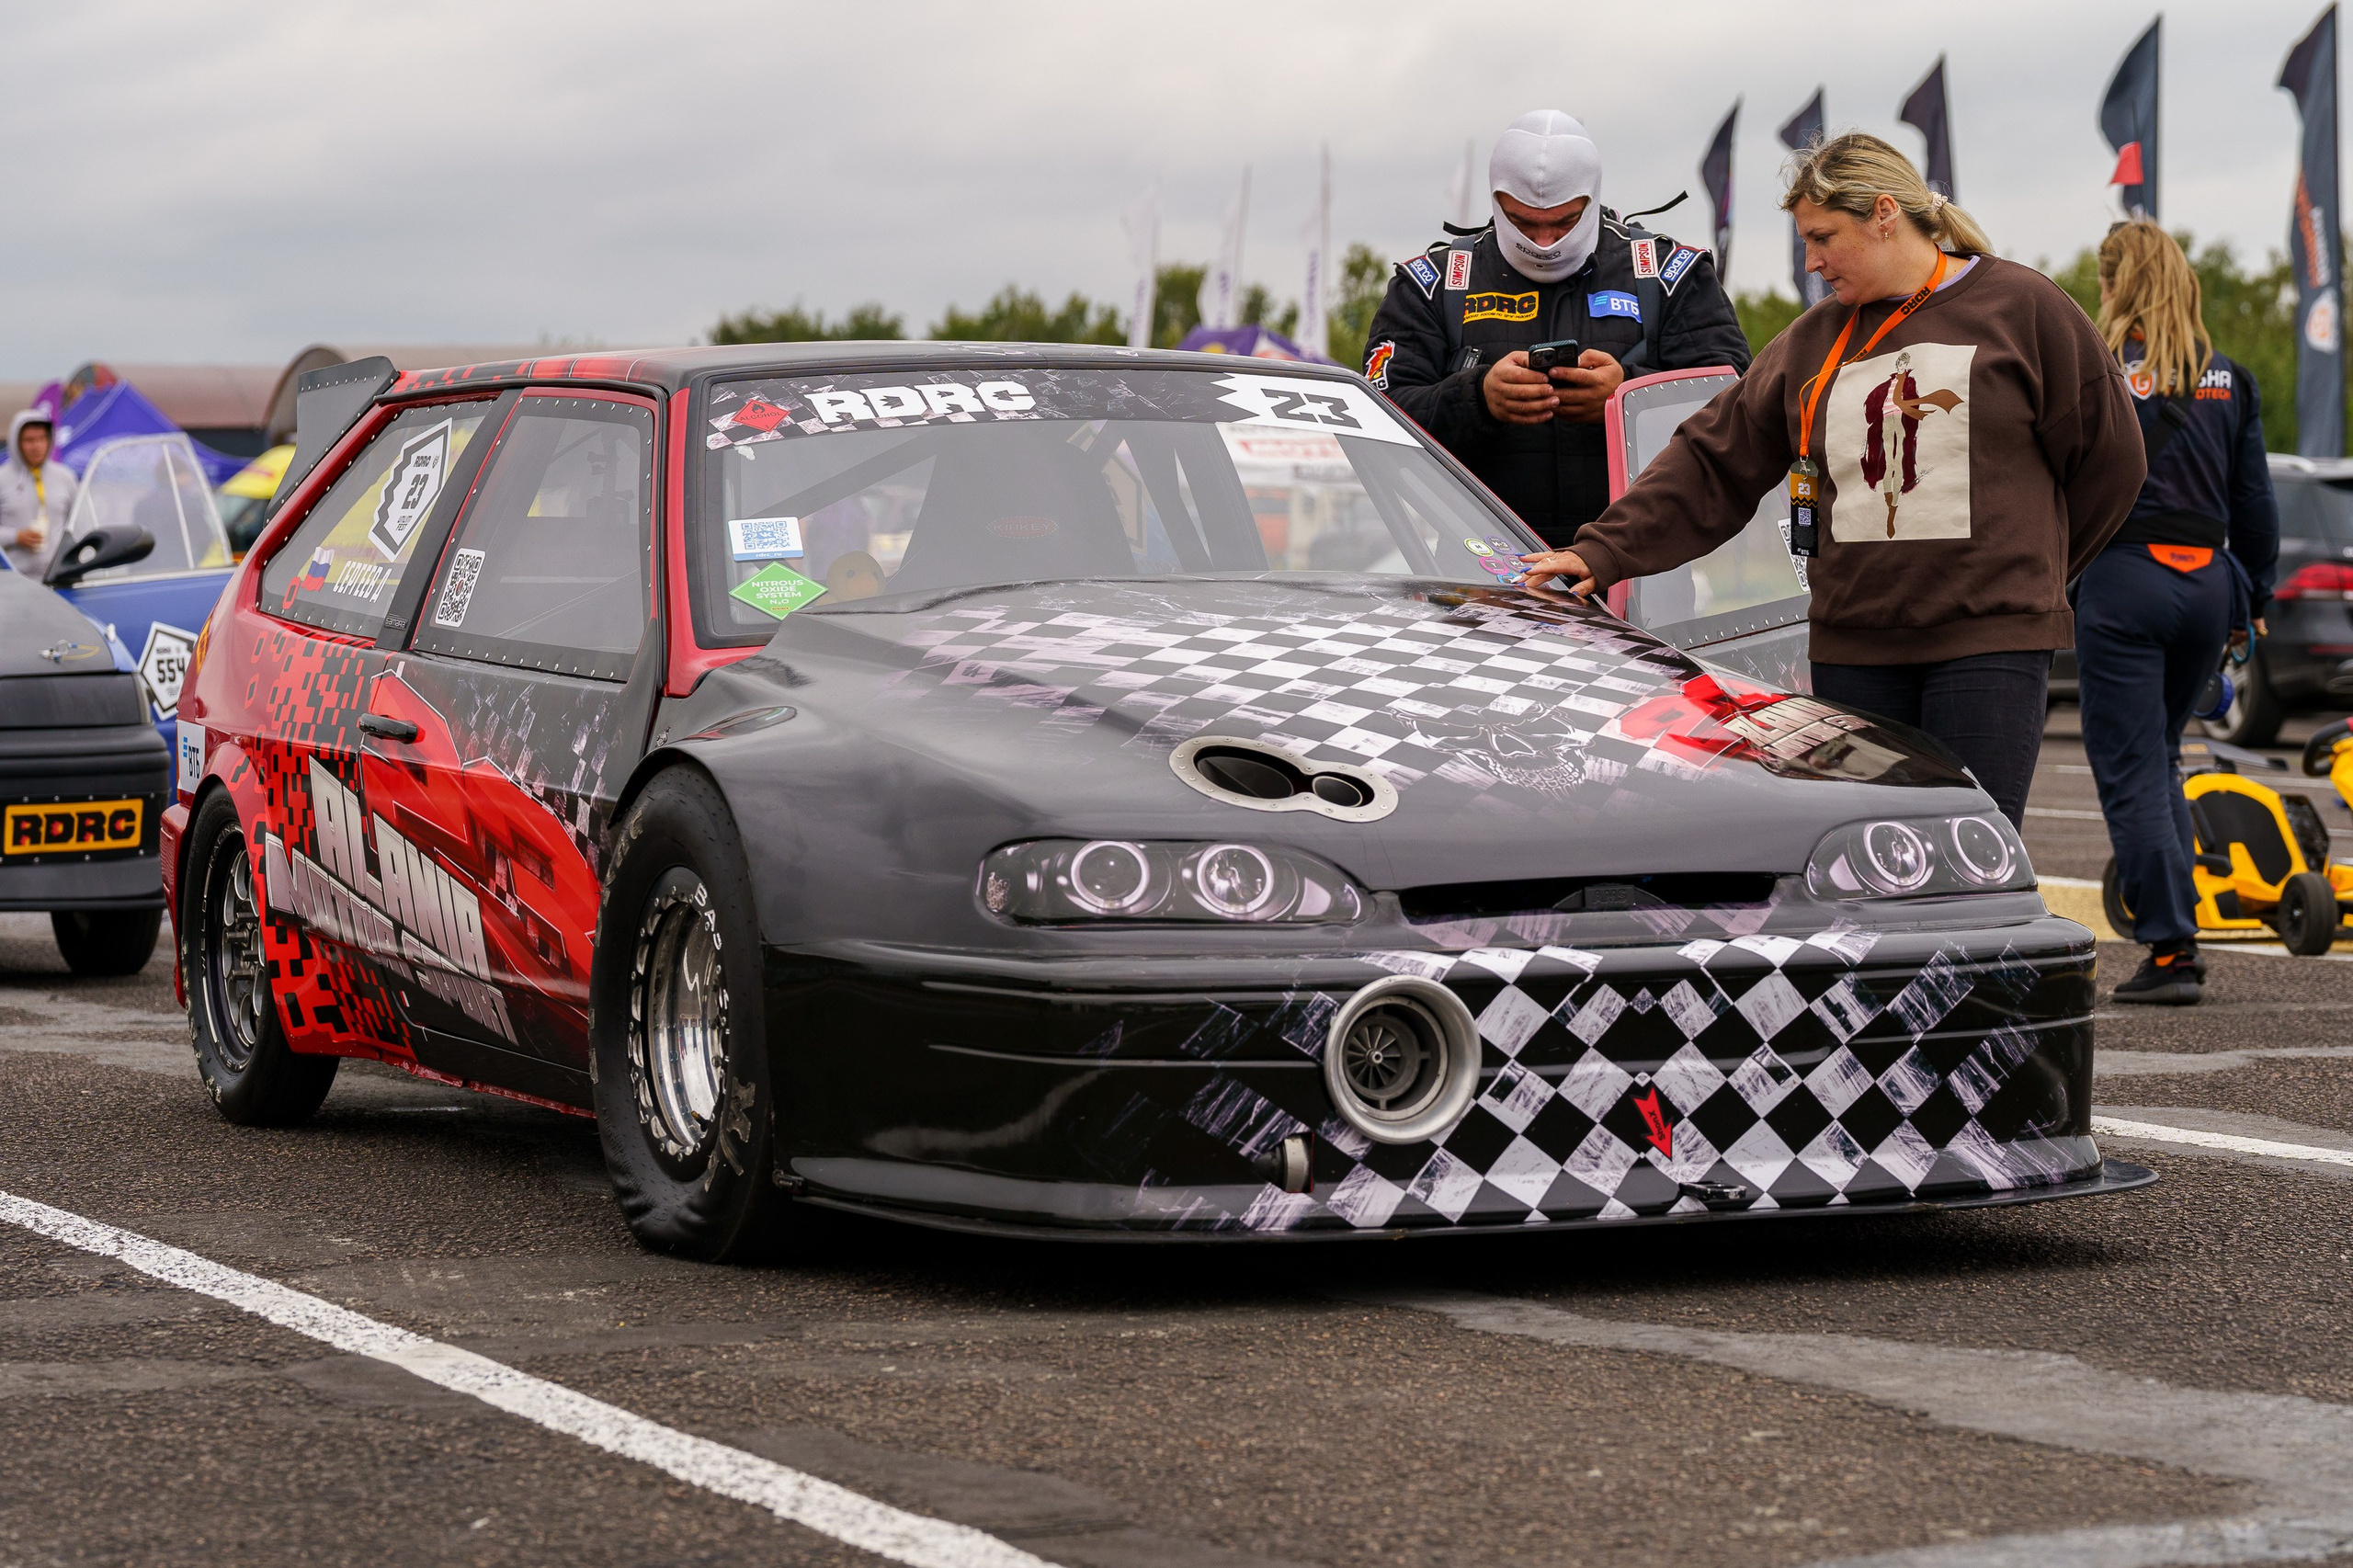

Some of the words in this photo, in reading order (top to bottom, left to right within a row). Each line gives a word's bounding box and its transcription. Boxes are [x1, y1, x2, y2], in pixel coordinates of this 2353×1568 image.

[1413, 258, 1434, 283] sparco
[1452, 254, 1466, 286] SIMPSON
[1638, 243, 1652, 273] SIMPSON
[1664, 249, 1692, 279] sparco
[1464, 295, 1536, 314] RDRC
[1610, 297, 1640, 316] ВТБ
[1901, 286, 1931, 314] RDRC
[803, 381, 1037, 424] RDRC
[1260, 388, 1362, 429] 23
[2195, 388, 2232, 400] OTECH
[740, 412, 781, 421] ALCOHOL
[402, 474, 429, 509] 23
[1798, 483, 1810, 495] 23
[994, 523, 1051, 531] KIRKEY
[333, 561, 383, 598] СЕРГЕЕВ
[157, 657, 185, 683] 554
[1722, 697, 1845, 747] ALANIA
[188, 745, 199, 778] ВТБ
[11, 809, 136, 846] RDRC
[308, 755, 492, 983] ALANIA
[1593, 888, 1627, 903] AMS
[265, 832, 415, 983] MOTOR
[402, 929, 519, 1047] SPORT
